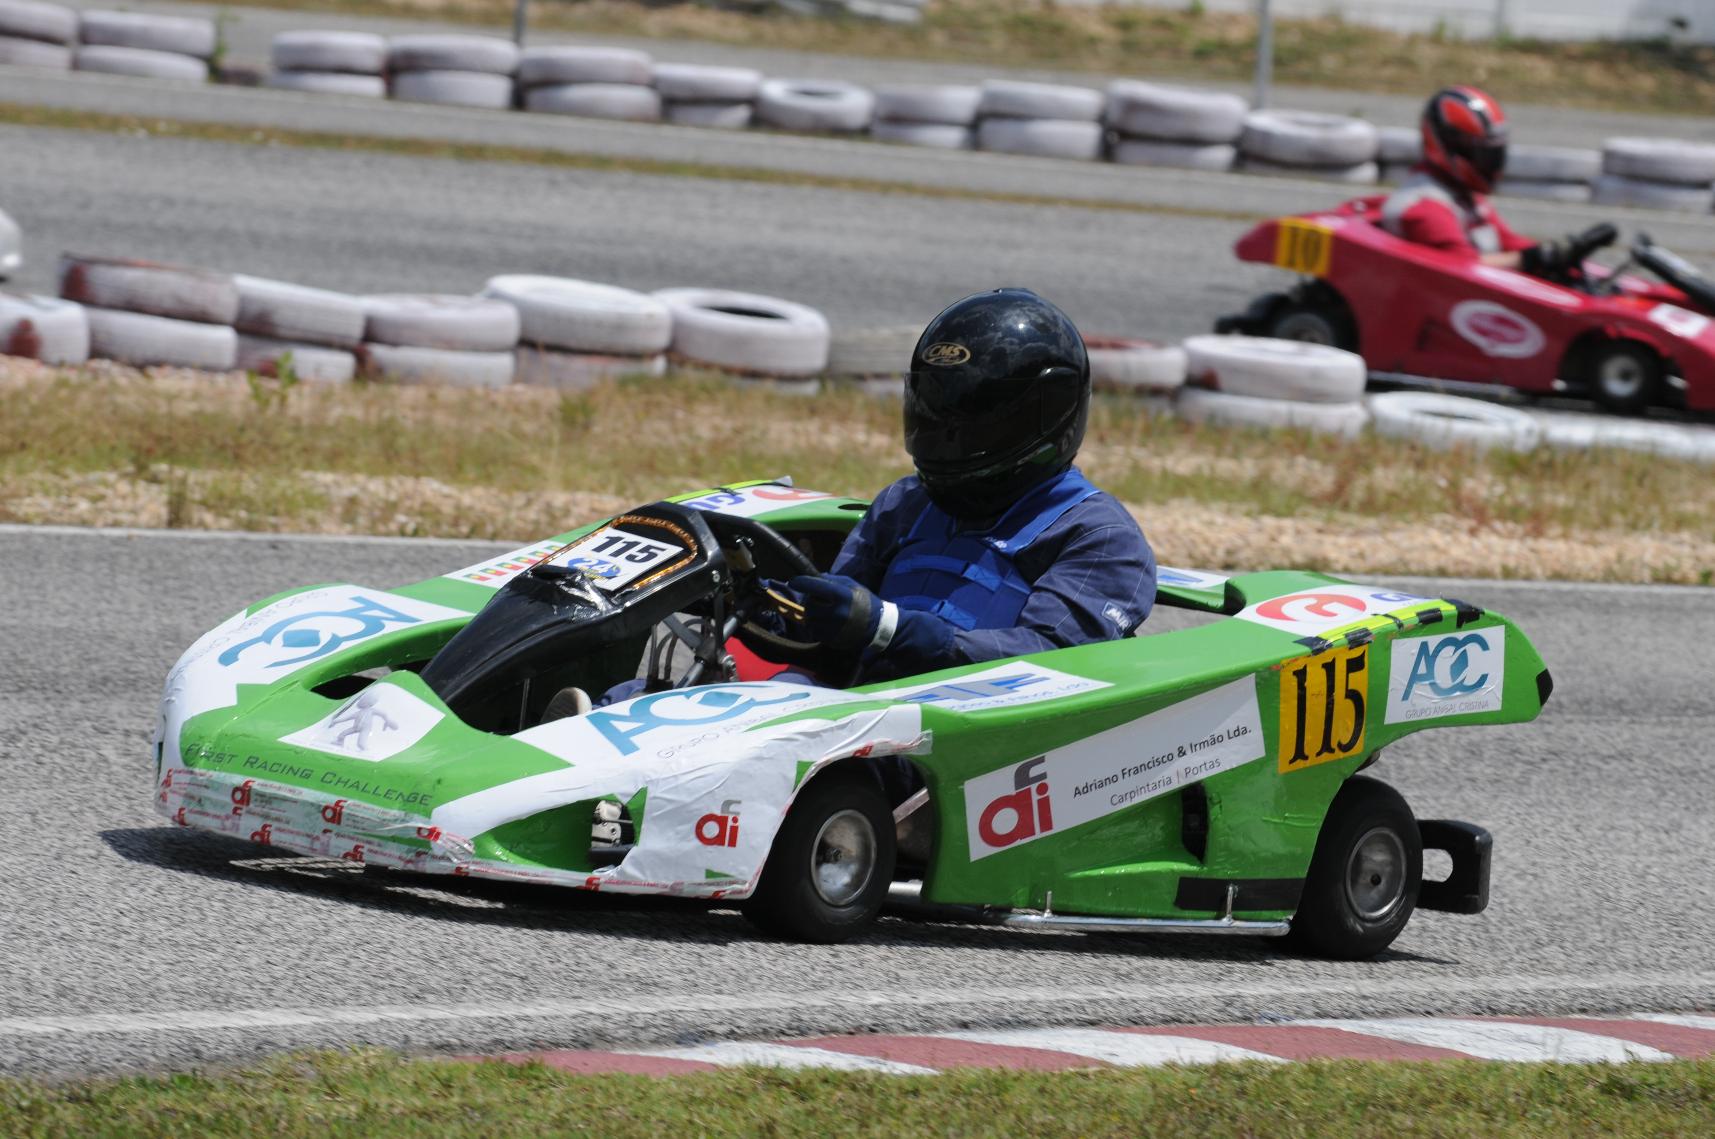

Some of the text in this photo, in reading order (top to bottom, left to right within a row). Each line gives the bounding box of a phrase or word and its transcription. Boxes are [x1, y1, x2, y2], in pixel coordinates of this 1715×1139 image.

[592, 536, 667, 563] 115
[1288, 650, 1366, 765] 115
[1073, 724, 1252, 798] Adriano Francisco & Irmão Lda.
[1110, 774, 1172, 806] Carpintaria
[1184, 757, 1221, 779] Portas
